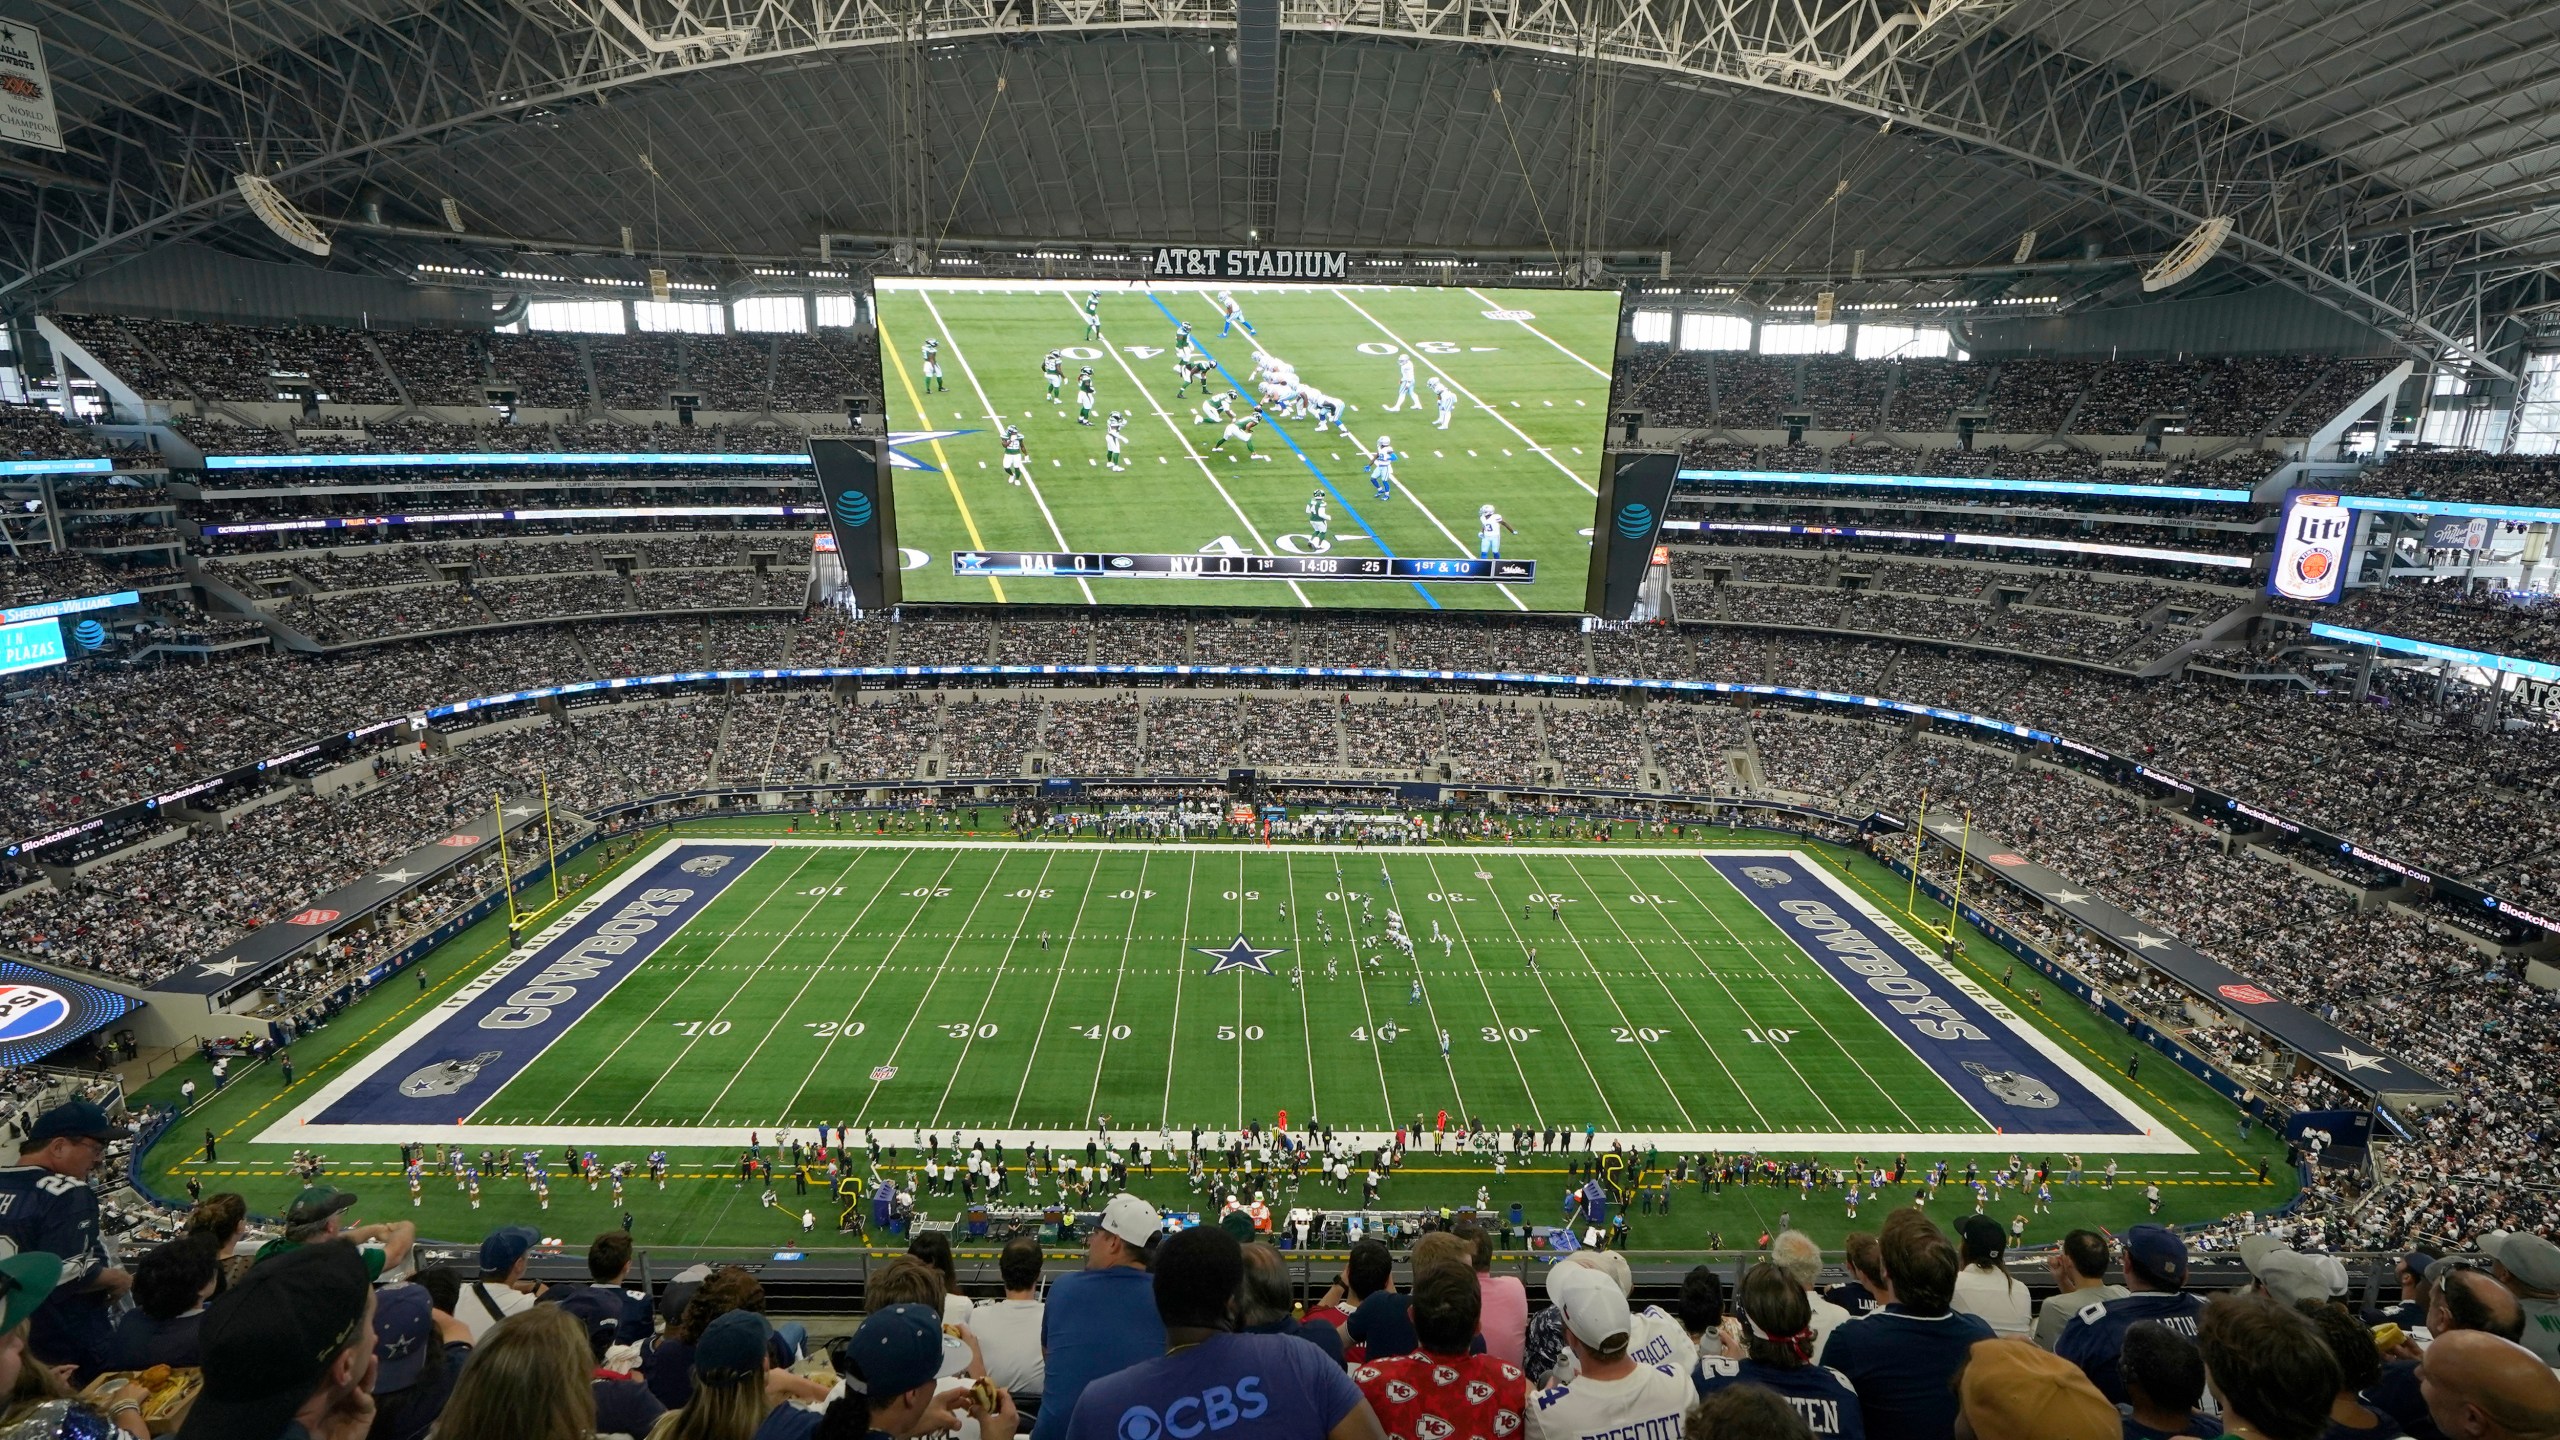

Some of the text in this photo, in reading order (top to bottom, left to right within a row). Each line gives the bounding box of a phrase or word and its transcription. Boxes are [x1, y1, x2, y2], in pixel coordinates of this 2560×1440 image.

[0, 45, 28, 59] ALLAS
[8, 104, 43, 120] WORLD
[0, 113, 56, 134] CHAMPIONS
[21, 129, 41, 141] 1995
[1154, 249, 1346, 277] AT&T STADIUM
[2297, 516, 2346, 545] Lite
[2434, 528, 2468, 544] Miller
[2470, 523, 2486, 533] Lite
[2448, 536, 2466, 544] TIME
[1020, 555, 1086, 571] DAL 0
[1171, 557, 1231, 573] NYJ 0
[1257, 559, 1274, 570] 1ST
[1299, 560, 1338, 573] 14:08
[1415, 561, 1470, 574] 1ST & 10
[7, 597, 112, 620] SHERWIN-WILLIAMS
[6, 641, 55, 663] PLAZAS
[355, 717, 407, 737] Blockchain.com
[267, 745, 320, 767] Blockchain.com
[2062, 739, 2109, 761] Blockchain.com
[2142, 769, 2194, 793] Blockchain.com
[158, 778, 223, 805] Blockchain.com
[2237, 804, 2299, 833] Blockchain.com
[22, 818, 103, 852] Blockchain.com
[2353, 847, 2430, 883] Blockchain.com
[809, 886, 848, 896] 10
[912, 888, 953, 898] 20
[1016, 889, 1055, 899] 30
[1120, 890, 1157, 900] 40
[1222, 891, 1260, 901] 50
[1325, 892, 1361, 902] 40
[1427, 893, 1464, 903] 30
[1528, 893, 1567, 903] 20
[1629, 895, 1666, 905] 10
[441, 901, 600, 1008] IT TAKES ALL OF US
[478, 888, 695, 1030] COWBOYS
[1778, 899, 1991, 1041] COWBOYS
[1867, 913, 2017, 1020] IT TAKES ALL OF US
[680, 1021, 731, 1036] 10
[813, 1022, 866, 1037] 20
[949, 1023, 998, 1038] 30
[1083, 1025, 1132, 1041] 40
[1217, 1025, 1264, 1041] 50
[1481, 1027, 1528, 1042] 30
[1610, 1027, 1660, 1042] 20
[1741, 1029, 1790, 1044] 10
[873, 1072, 893, 1080] NFL
[1165, 1376, 1268, 1439] CBS
[1783, 1397, 1839, 1434] TEN
[1581, 1413, 1681, 1440] SCOTT
